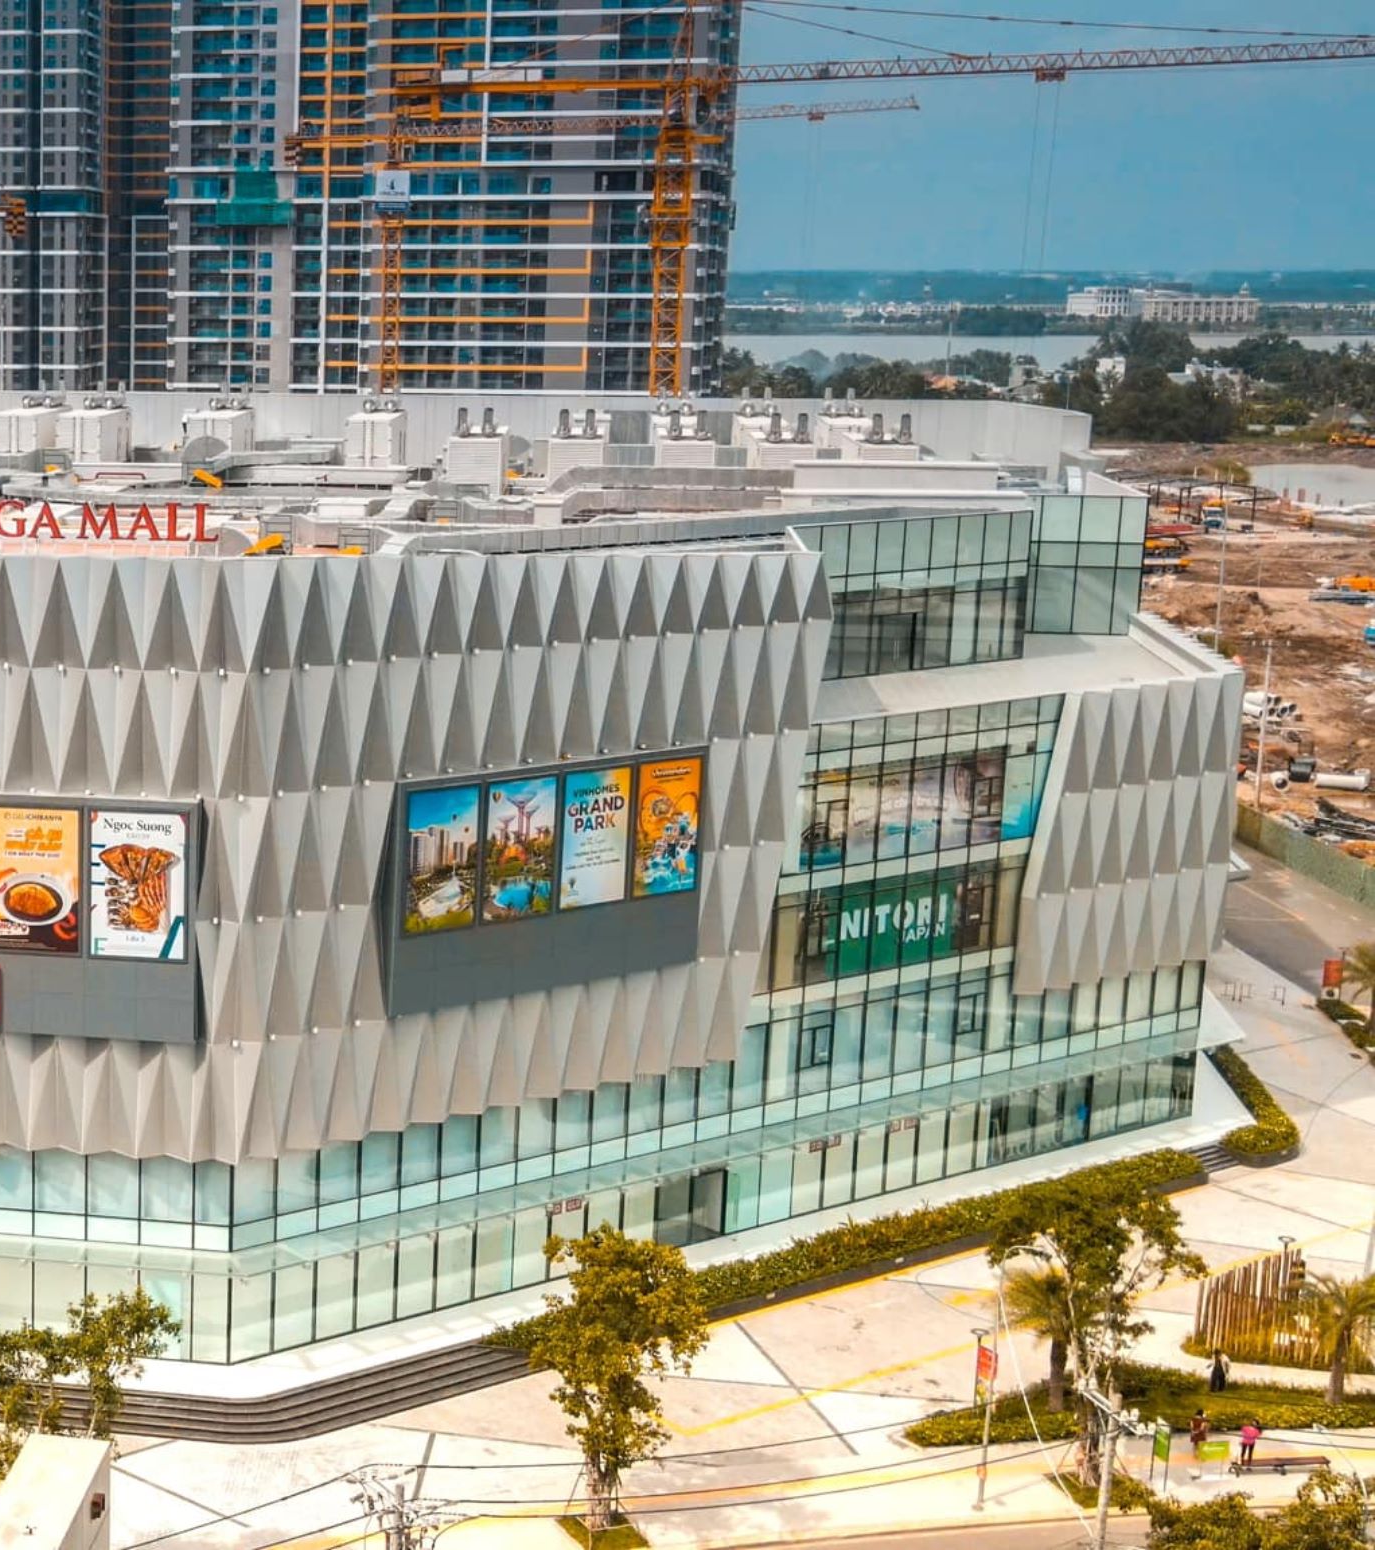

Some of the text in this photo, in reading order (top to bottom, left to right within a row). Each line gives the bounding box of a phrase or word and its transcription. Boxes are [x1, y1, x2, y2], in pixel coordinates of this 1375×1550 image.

[75, 501, 219, 542] MALL
[573, 783, 620, 798] VINHOMES
[568, 796, 625, 817] GRAND
[574, 811, 616, 834] PARK
[840, 893, 948, 941] NITORI
